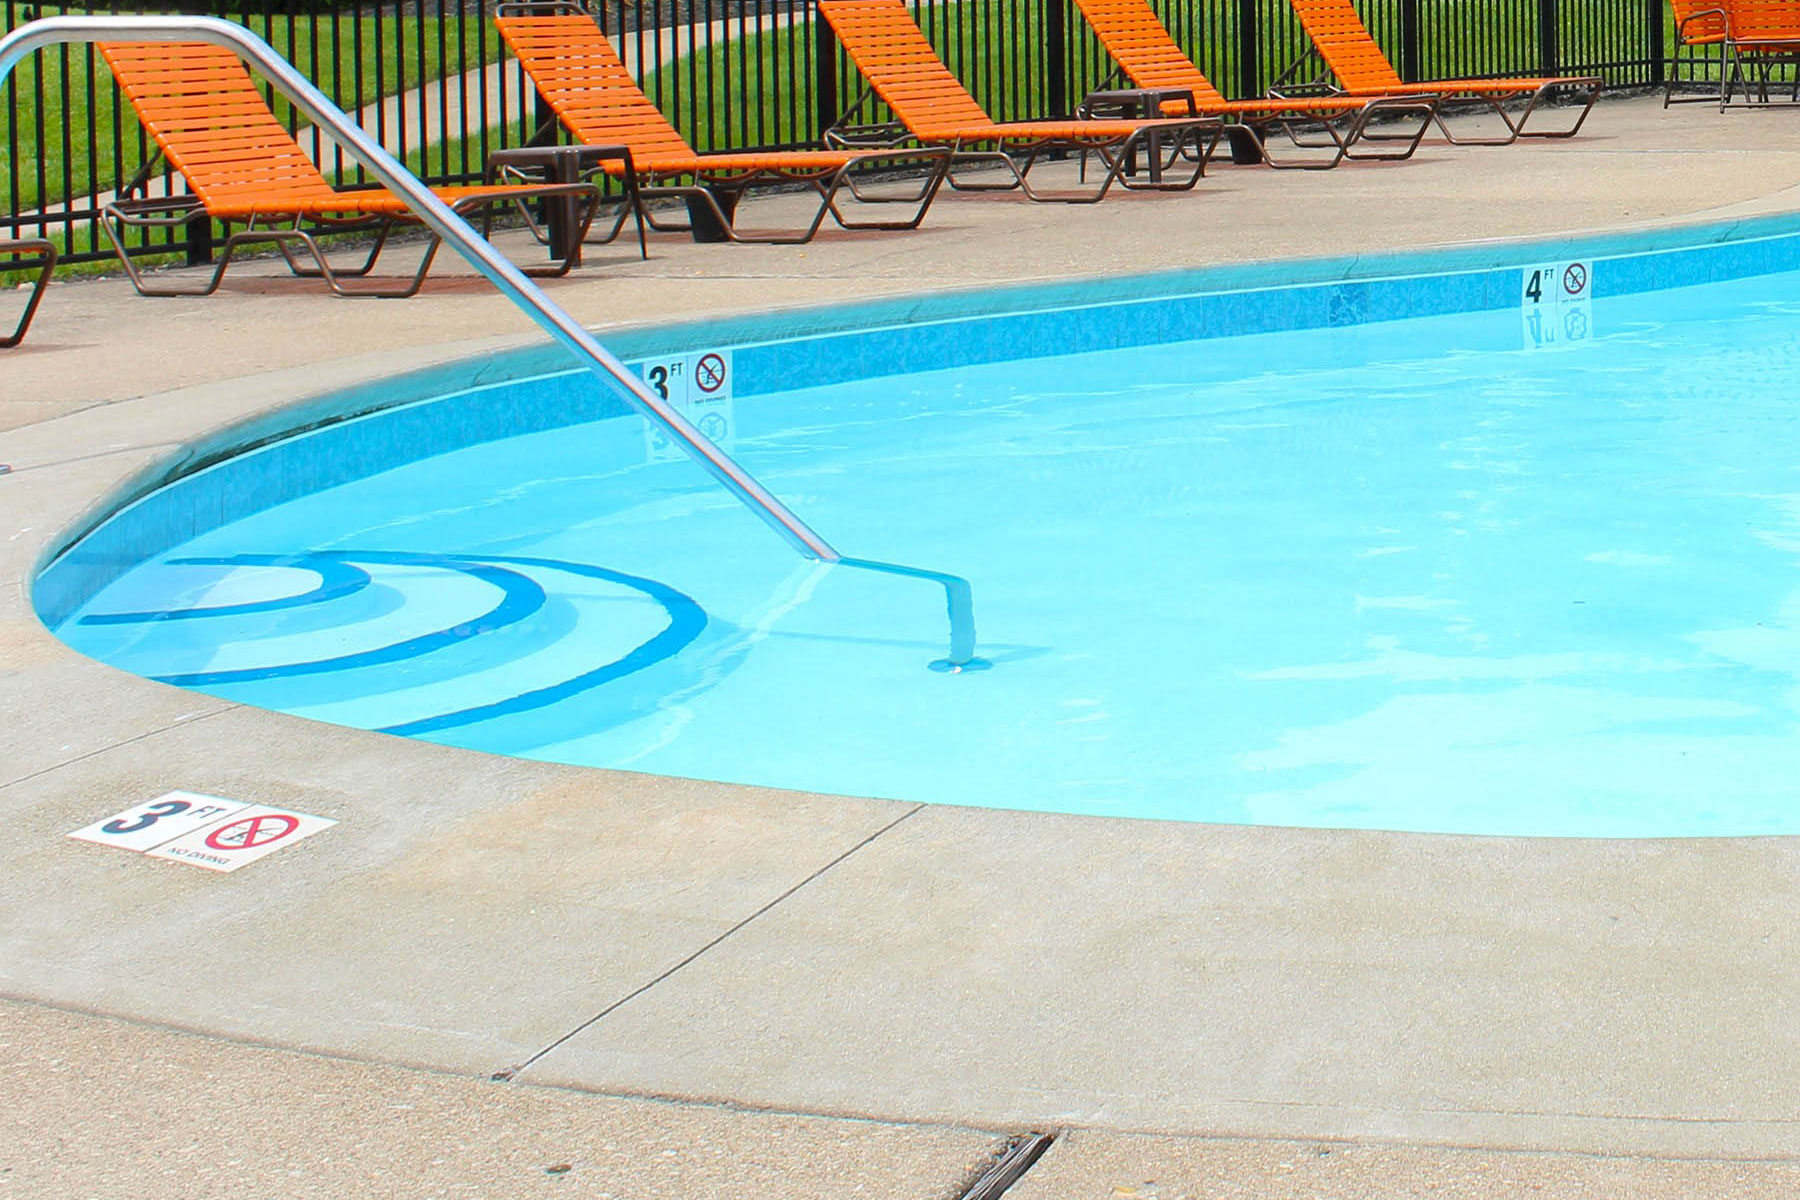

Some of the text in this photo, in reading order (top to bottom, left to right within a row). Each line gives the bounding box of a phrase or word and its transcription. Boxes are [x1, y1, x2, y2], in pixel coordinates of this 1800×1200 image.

[1526, 269, 1554, 303] 4 FT
[649, 362, 683, 401] 3 FT
[101, 800, 228, 834] 3 FT
[168, 847, 188, 855] NO
